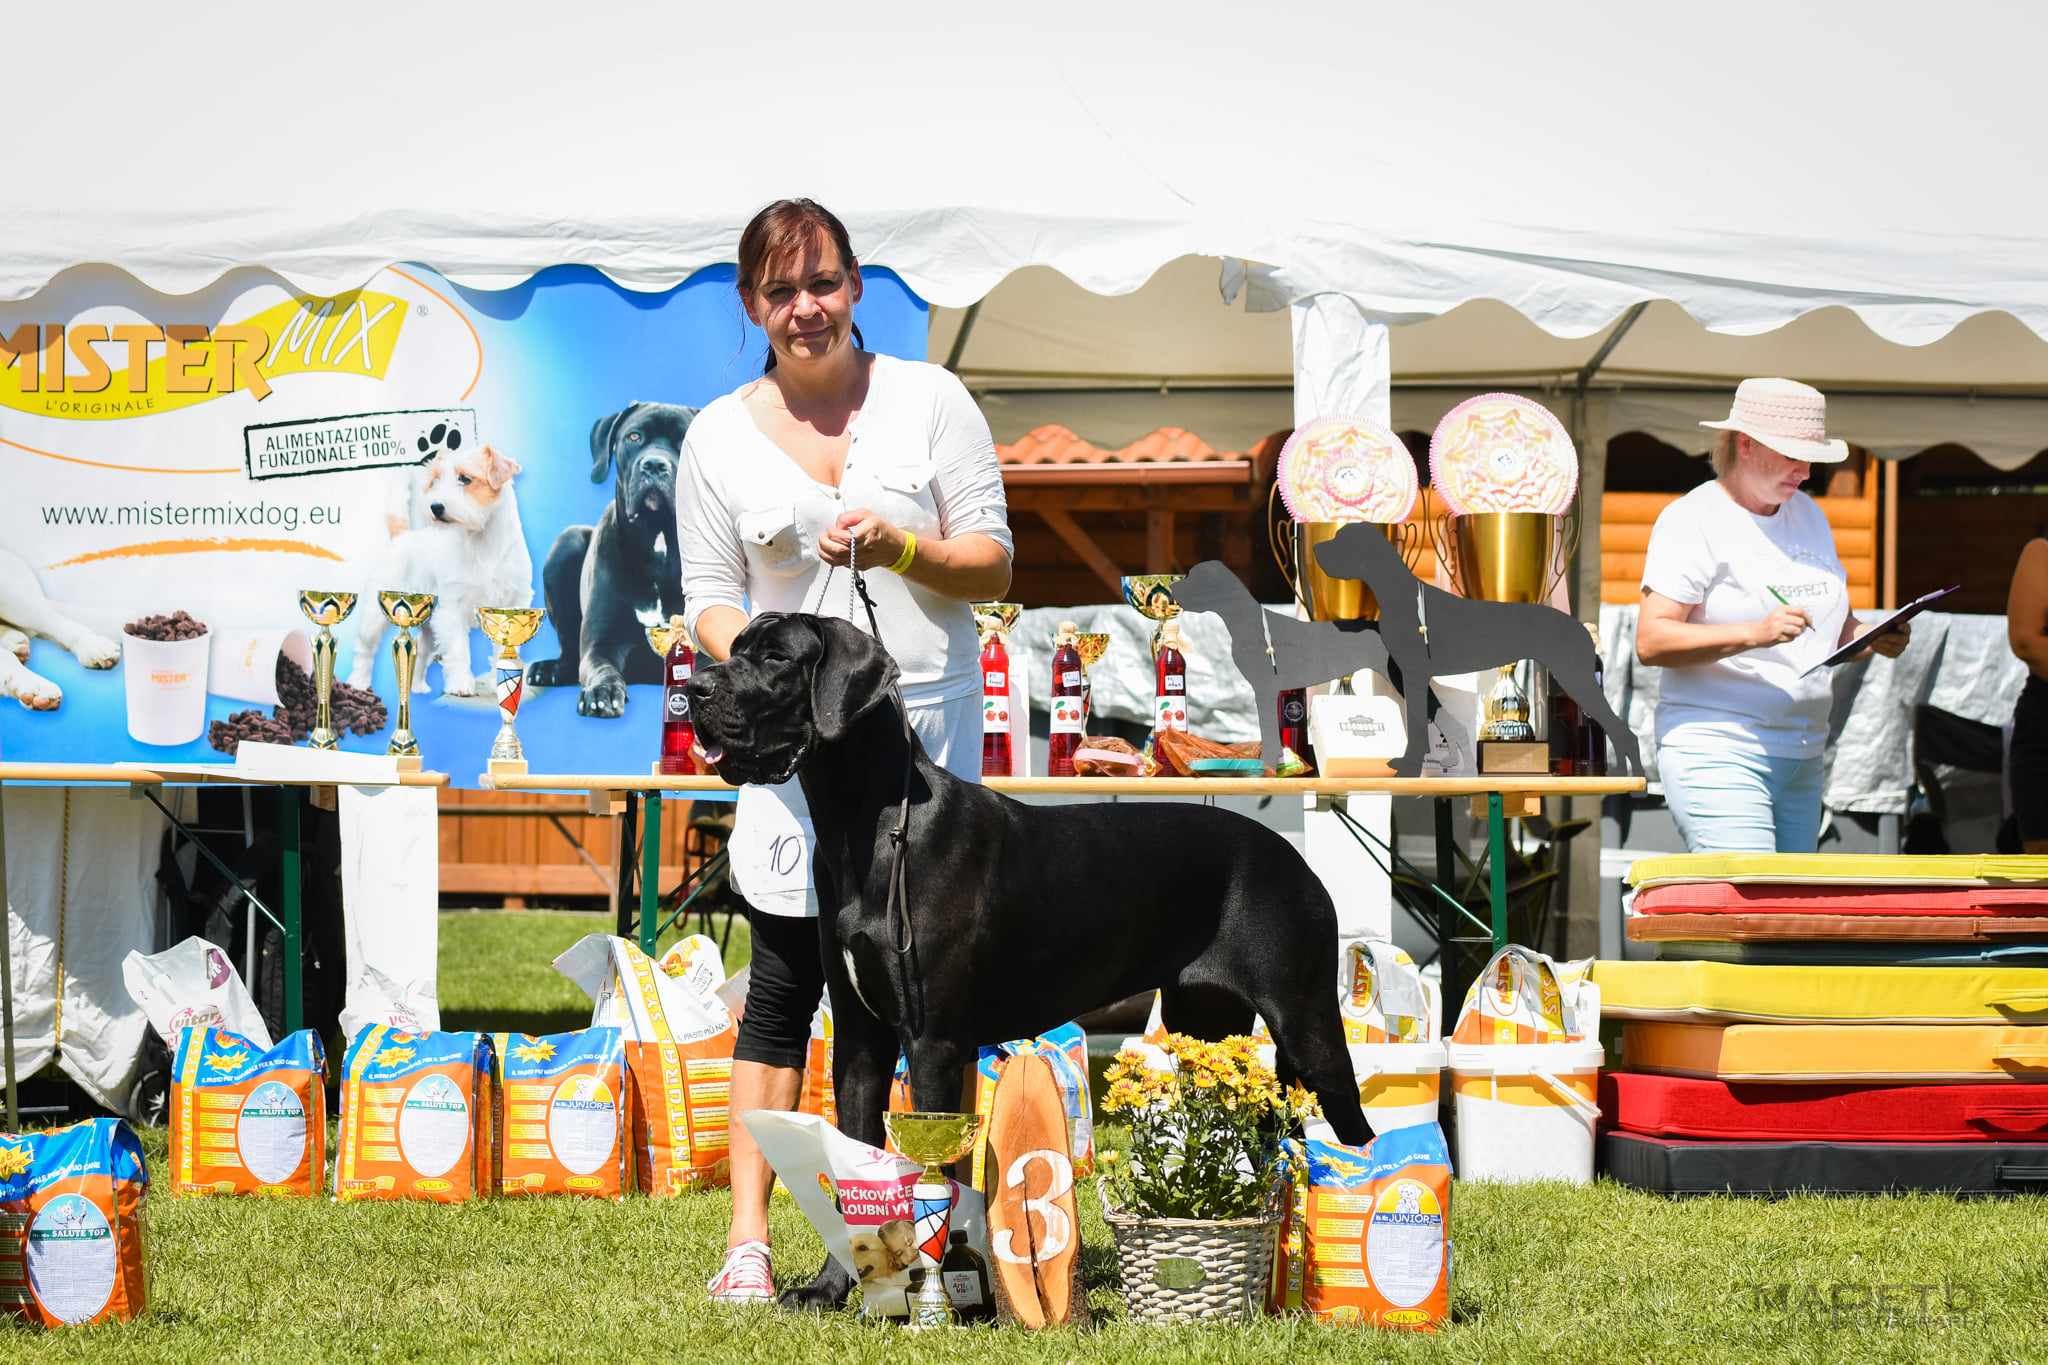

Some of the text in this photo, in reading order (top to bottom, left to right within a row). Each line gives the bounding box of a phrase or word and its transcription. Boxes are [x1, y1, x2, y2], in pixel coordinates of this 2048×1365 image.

[266, 299, 396, 371] MIX
[45, 398, 157, 414] L'ORIGINALE
[265, 424, 392, 451] ALIMENTAZIONE
[258, 440, 406, 469] FUNZIONALE 100%
[42, 501, 341, 531] www.mistermixdog.eu
[769, 835, 801, 876] 10
[567, 1100, 603, 1109] JUNIOR
[661, 1034, 689, 1161] NATURAL
[182, 1085, 192, 1169] NATURAL
[346, 1080, 358, 1166] NATURAL
[1413, 1153, 1431, 1161] CANE
[837, 1185, 895, 1201] PIČKOVÁ
[993, 1149, 1073, 1264] 3
[52, 1229, 87, 1237] SALUTE
[88, 1228, 106, 1236] TOP
[1389, 1213, 1430, 1224] JUNIOR
